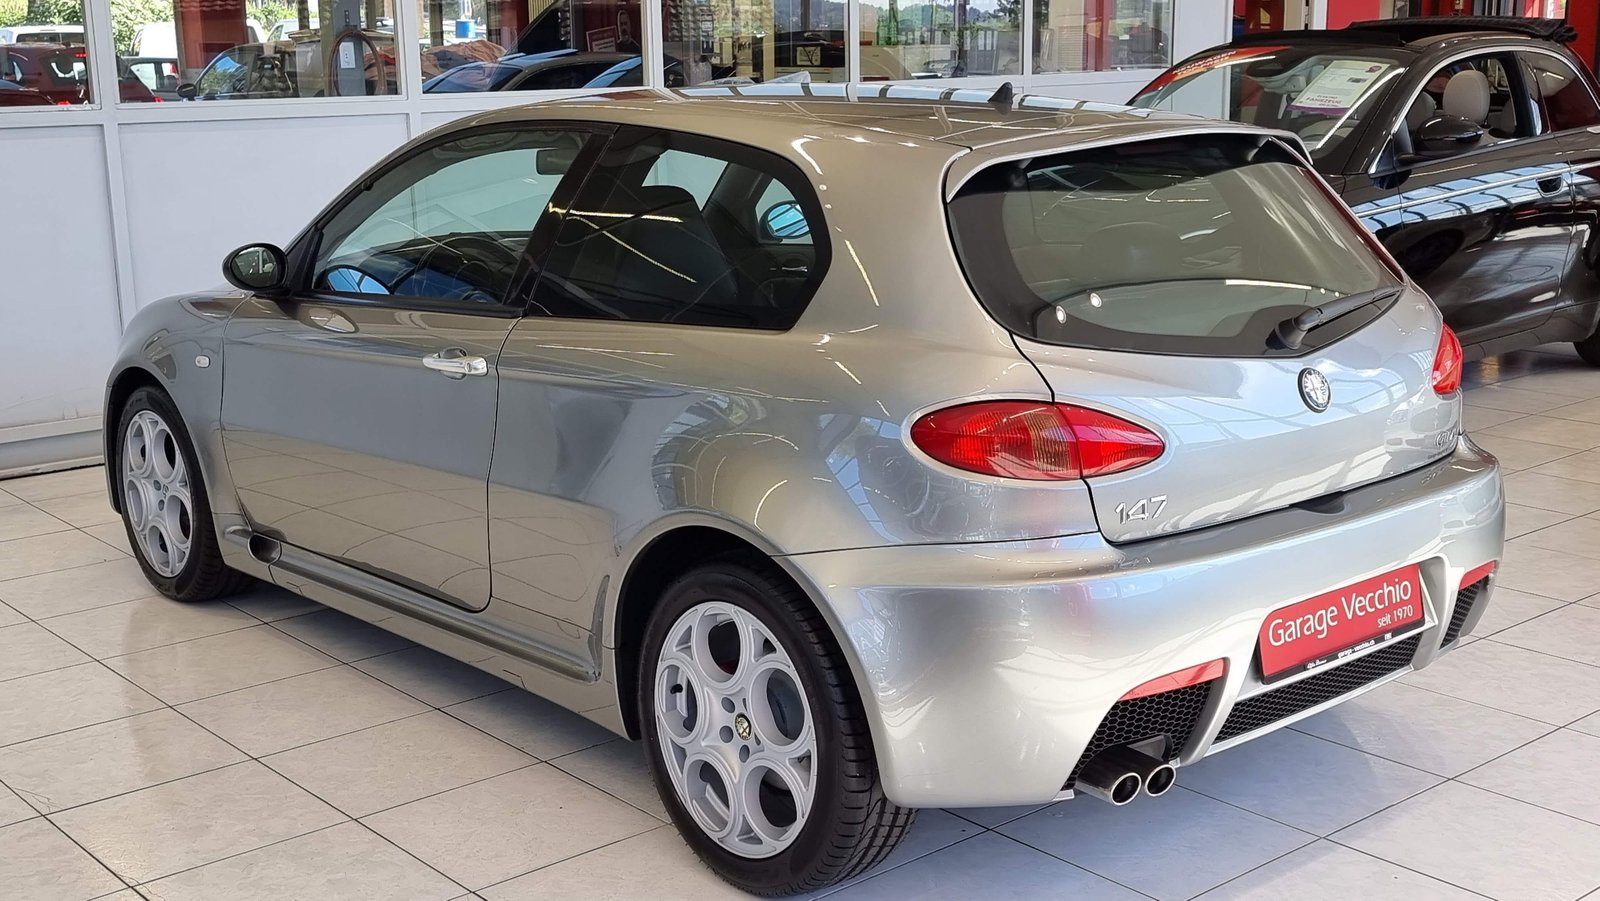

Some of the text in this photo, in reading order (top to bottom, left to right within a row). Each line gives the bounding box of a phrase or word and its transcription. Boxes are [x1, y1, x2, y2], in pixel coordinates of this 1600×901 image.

[1115, 495, 1167, 525] 147
[1269, 578, 1412, 646] Garage Vecchio
[1377, 604, 1413, 628] seit 1970
